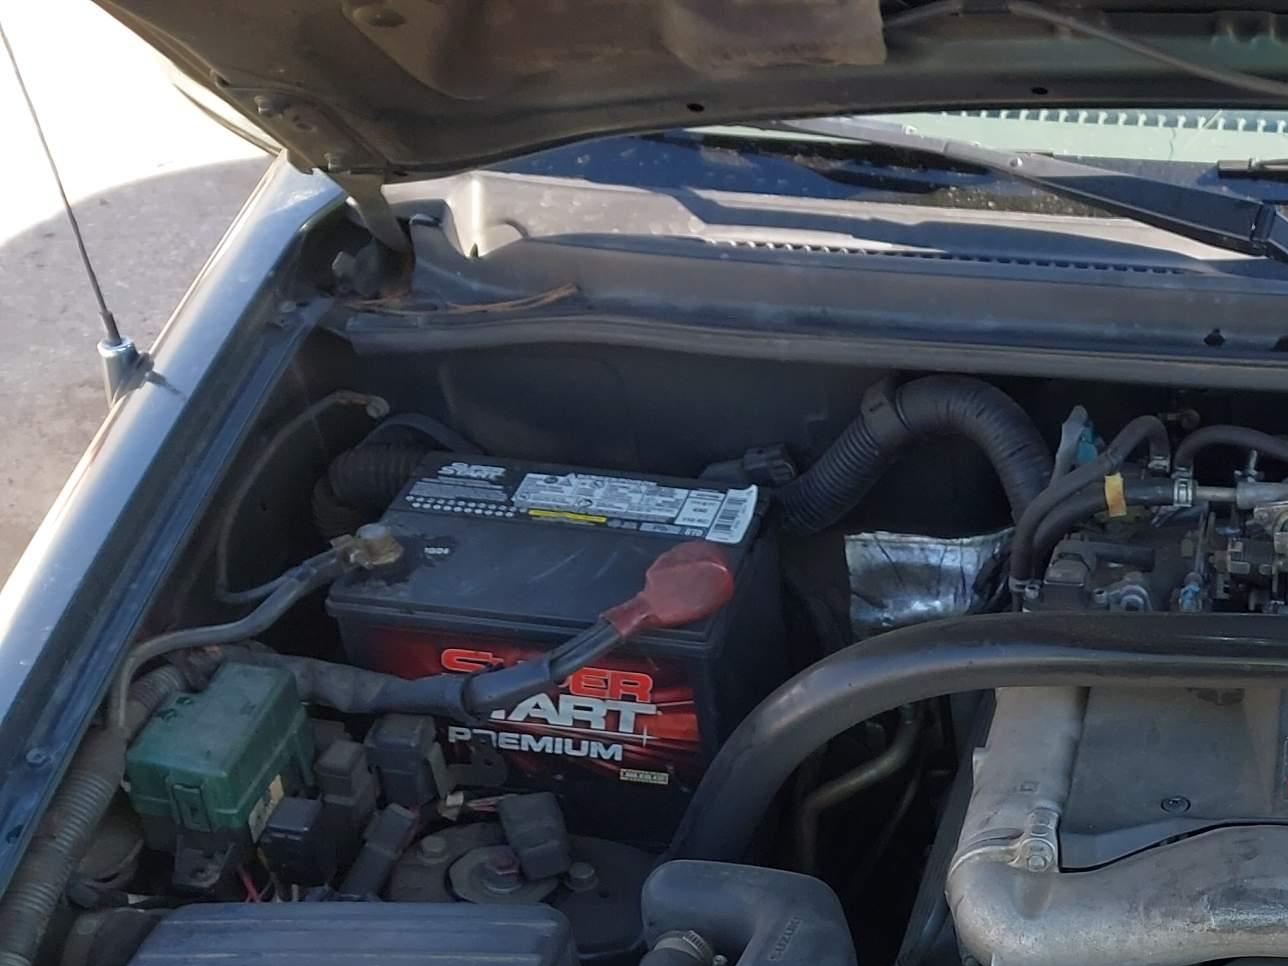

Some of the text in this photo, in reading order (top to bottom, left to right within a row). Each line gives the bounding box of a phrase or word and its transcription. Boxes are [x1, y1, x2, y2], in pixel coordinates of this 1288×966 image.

[441, 648, 654, 703] SER
[490, 692, 663, 734] ART
[448, 725, 623, 761] PREMIUM
